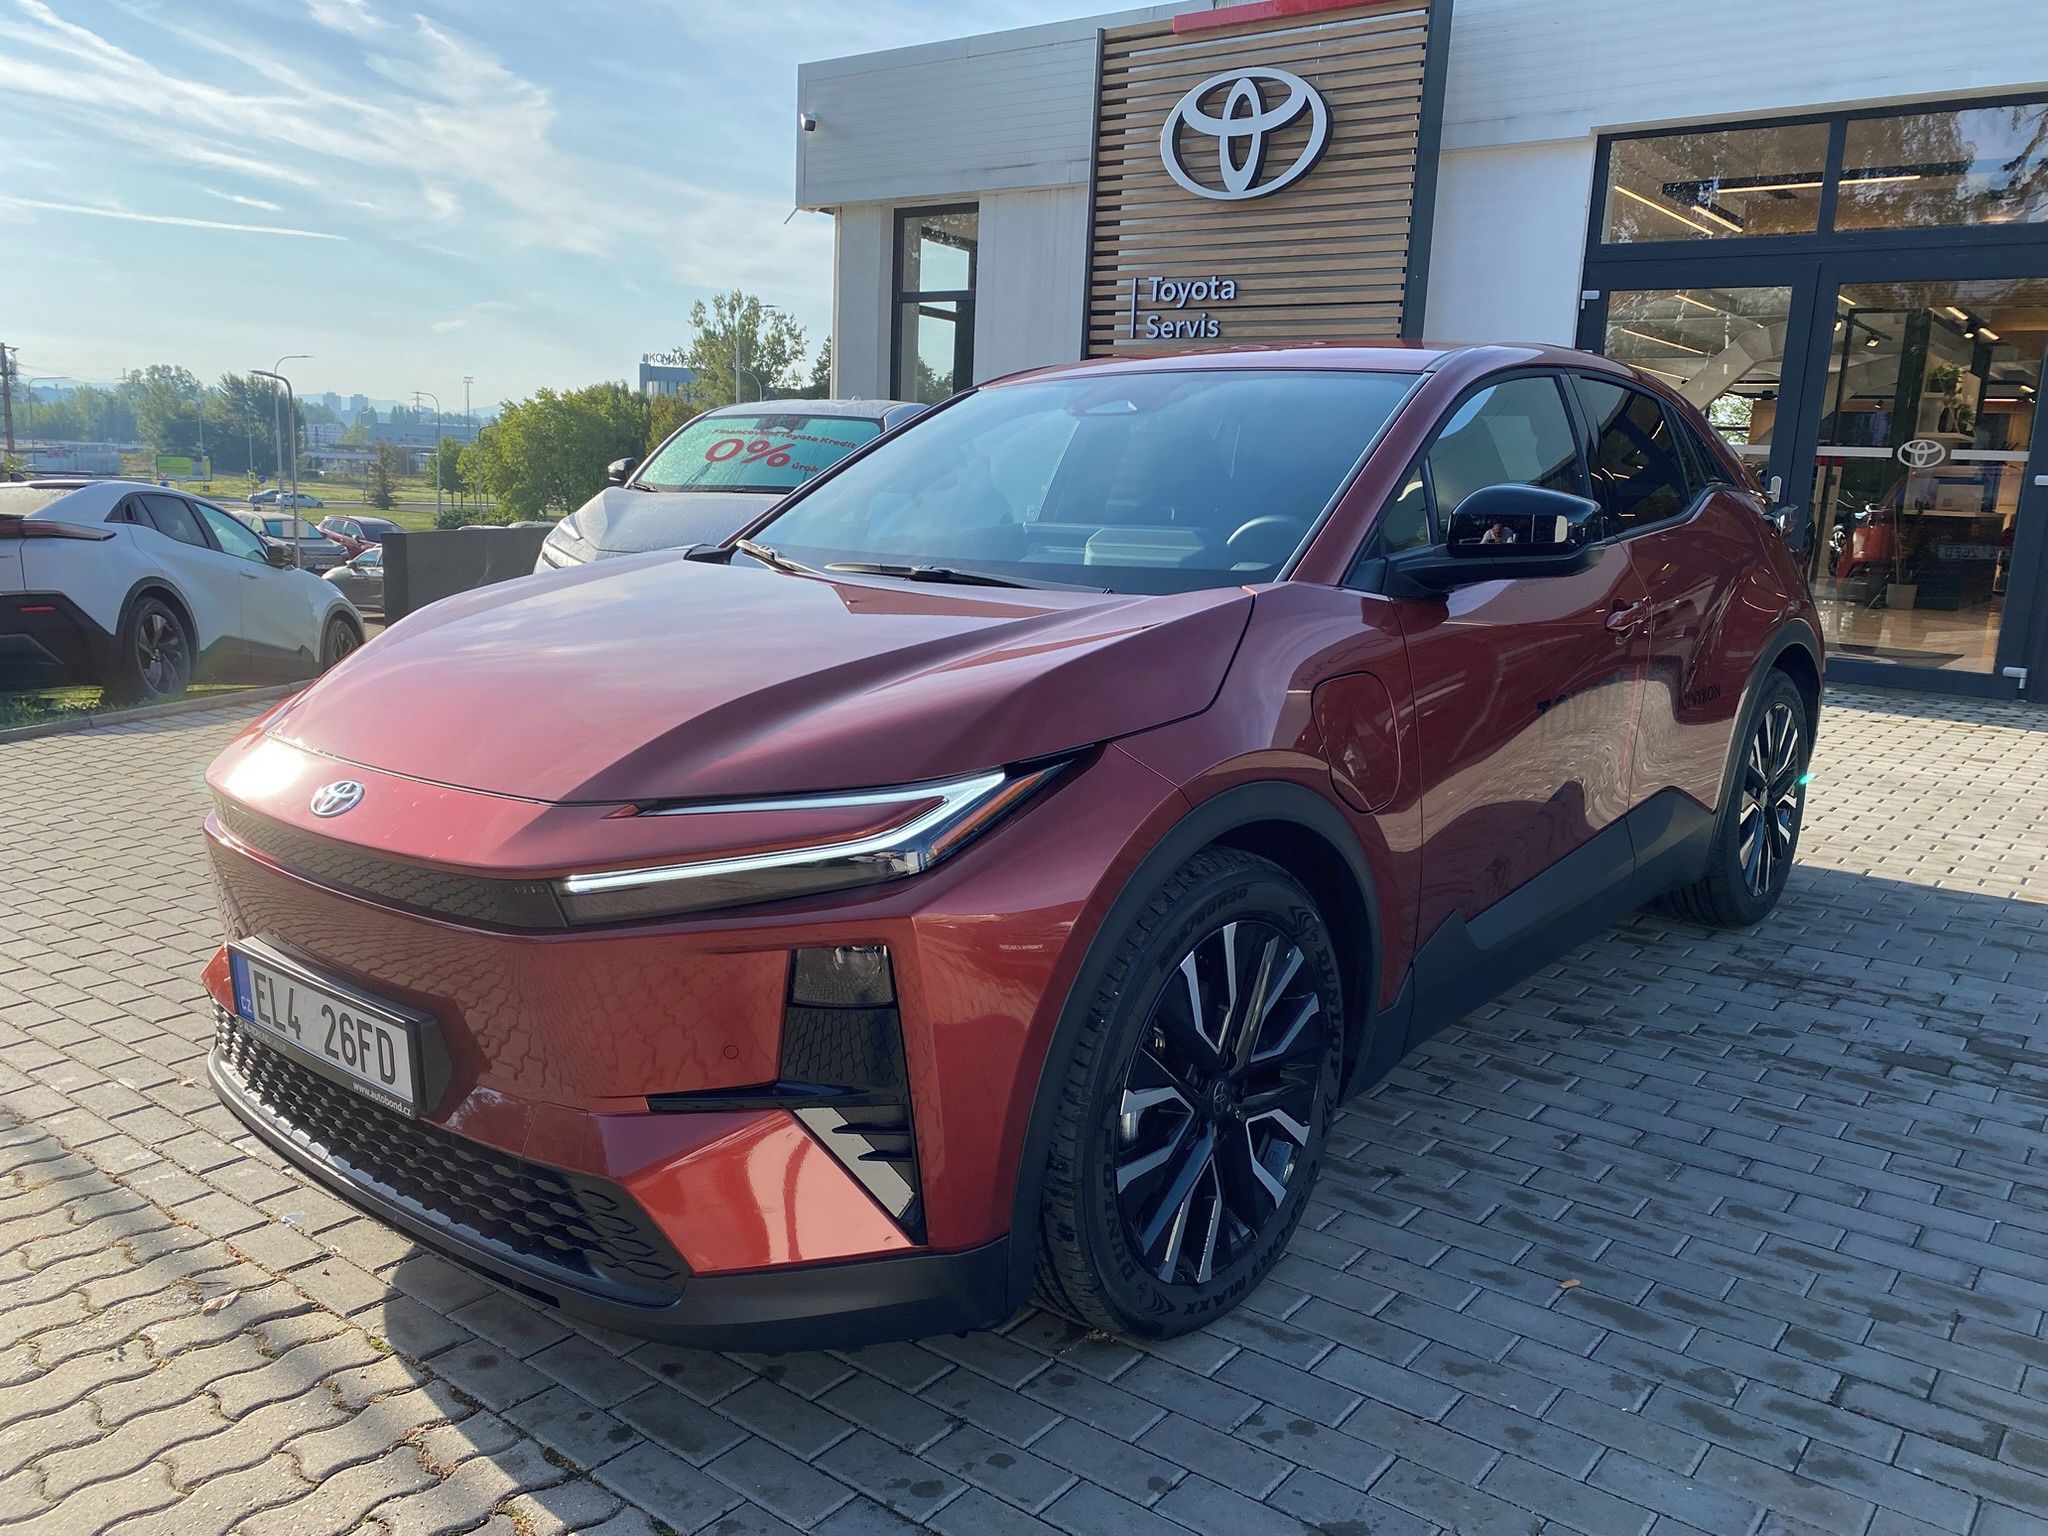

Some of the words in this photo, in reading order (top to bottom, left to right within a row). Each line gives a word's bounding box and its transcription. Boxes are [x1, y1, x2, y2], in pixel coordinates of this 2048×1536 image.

[1148, 275, 1237, 309] Toyota
[1145, 312, 1221, 339] Servis
[704, 438, 796, 468] 0%
[780, 431, 819, 442] Toyota
[820, 437, 858, 449] Kredit
[792, 462, 819, 474] úrok
[240, 994, 253, 1014] CZ
[1315, 945, 1343, 1080] DUNLOP
[252, 969, 302, 1042] EL4
[321, 1003, 397, 1086] 26FD
[352, 1080, 412, 1117] www.autobond.cz
[1103, 1129, 1137, 1283] DUNLOP
[1252, 1189, 1306, 1278] SPORT
